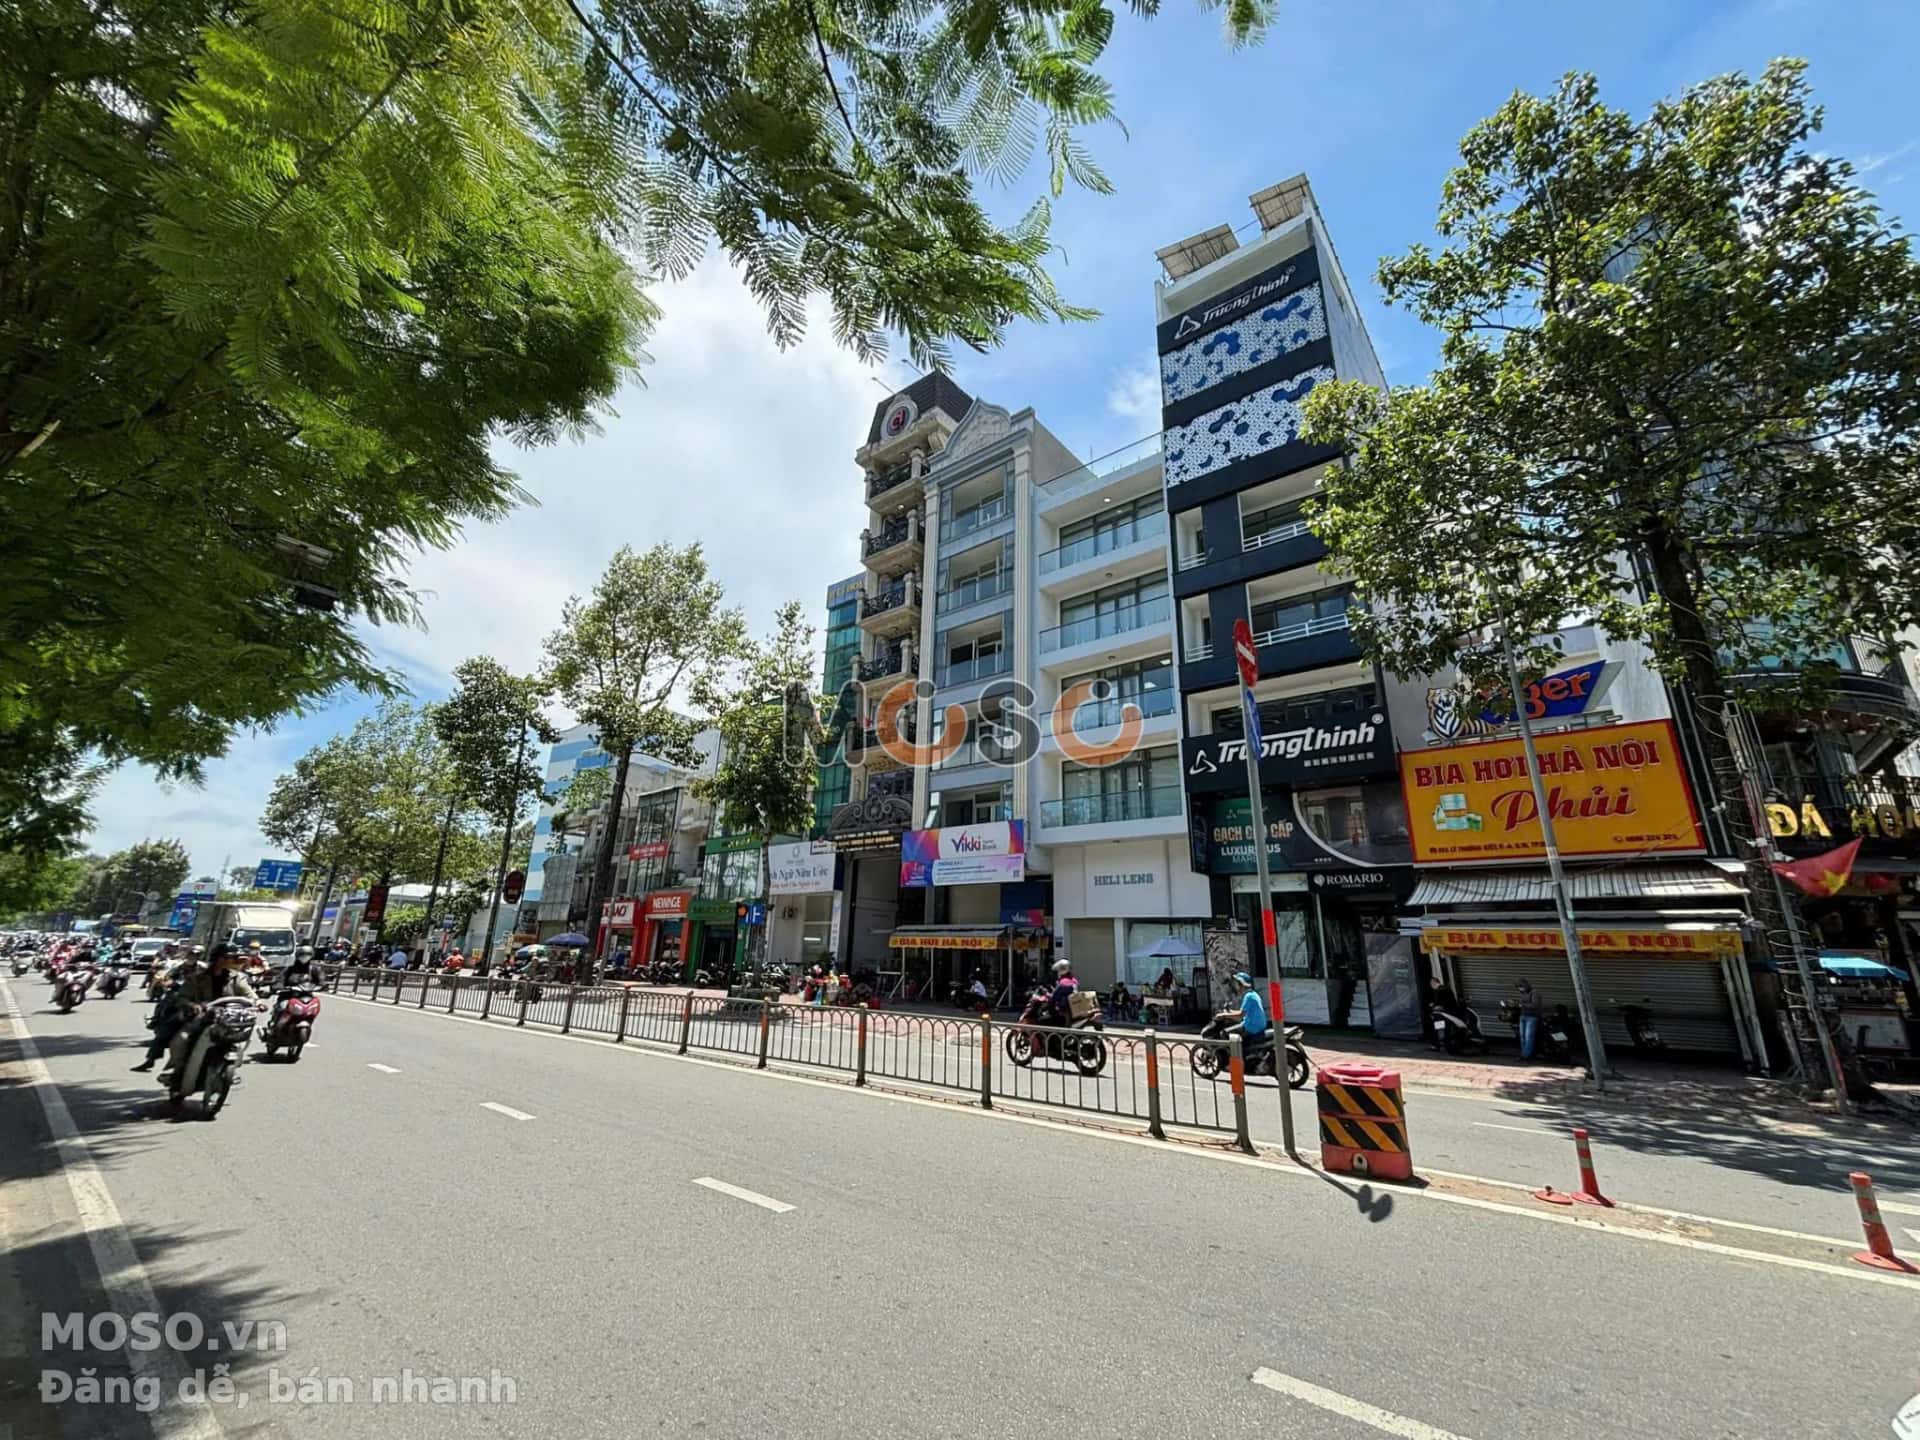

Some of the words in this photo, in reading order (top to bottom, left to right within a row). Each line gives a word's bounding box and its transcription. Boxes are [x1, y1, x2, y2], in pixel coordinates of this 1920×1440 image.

[1414, 762, 1465, 787] BIA
[1591, 736, 1662, 773] NỘI
[951, 830, 982, 853] Vikki
[1221, 843, 1281, 857] LUXURUS
[1326, 873, 1384, 886] ROMARIO
